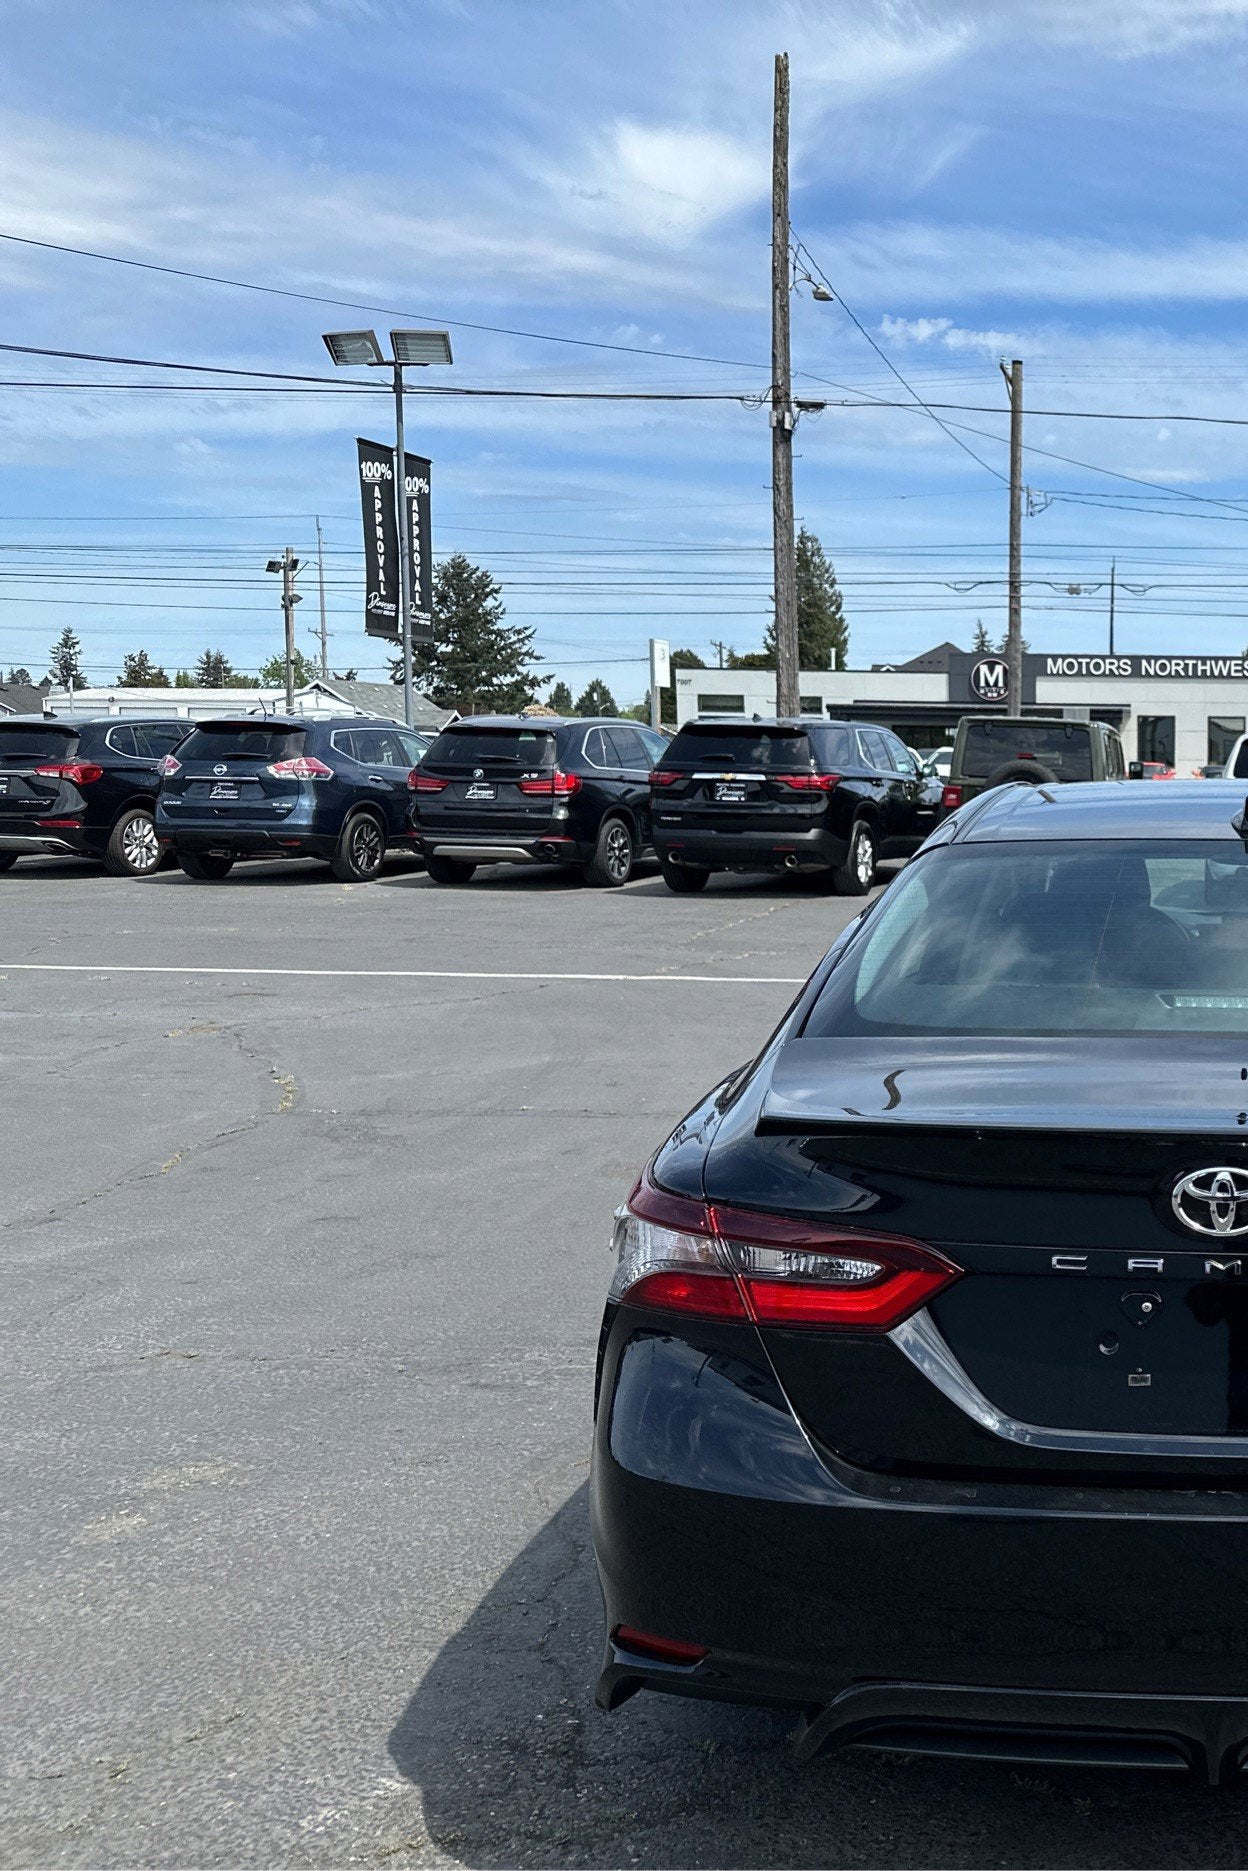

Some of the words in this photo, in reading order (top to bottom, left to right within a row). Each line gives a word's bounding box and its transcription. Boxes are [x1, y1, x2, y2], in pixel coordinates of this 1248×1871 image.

[361, 461, 392, 480] 100%
[405, 476, 429, 494] 00%
[374, 485, 386, 596] APPROVAL
[411, 499, 421, 605] APPROVAL
[979, 664, 1004, 687] M
[1046, 657, 1132, 676] MOTORS
